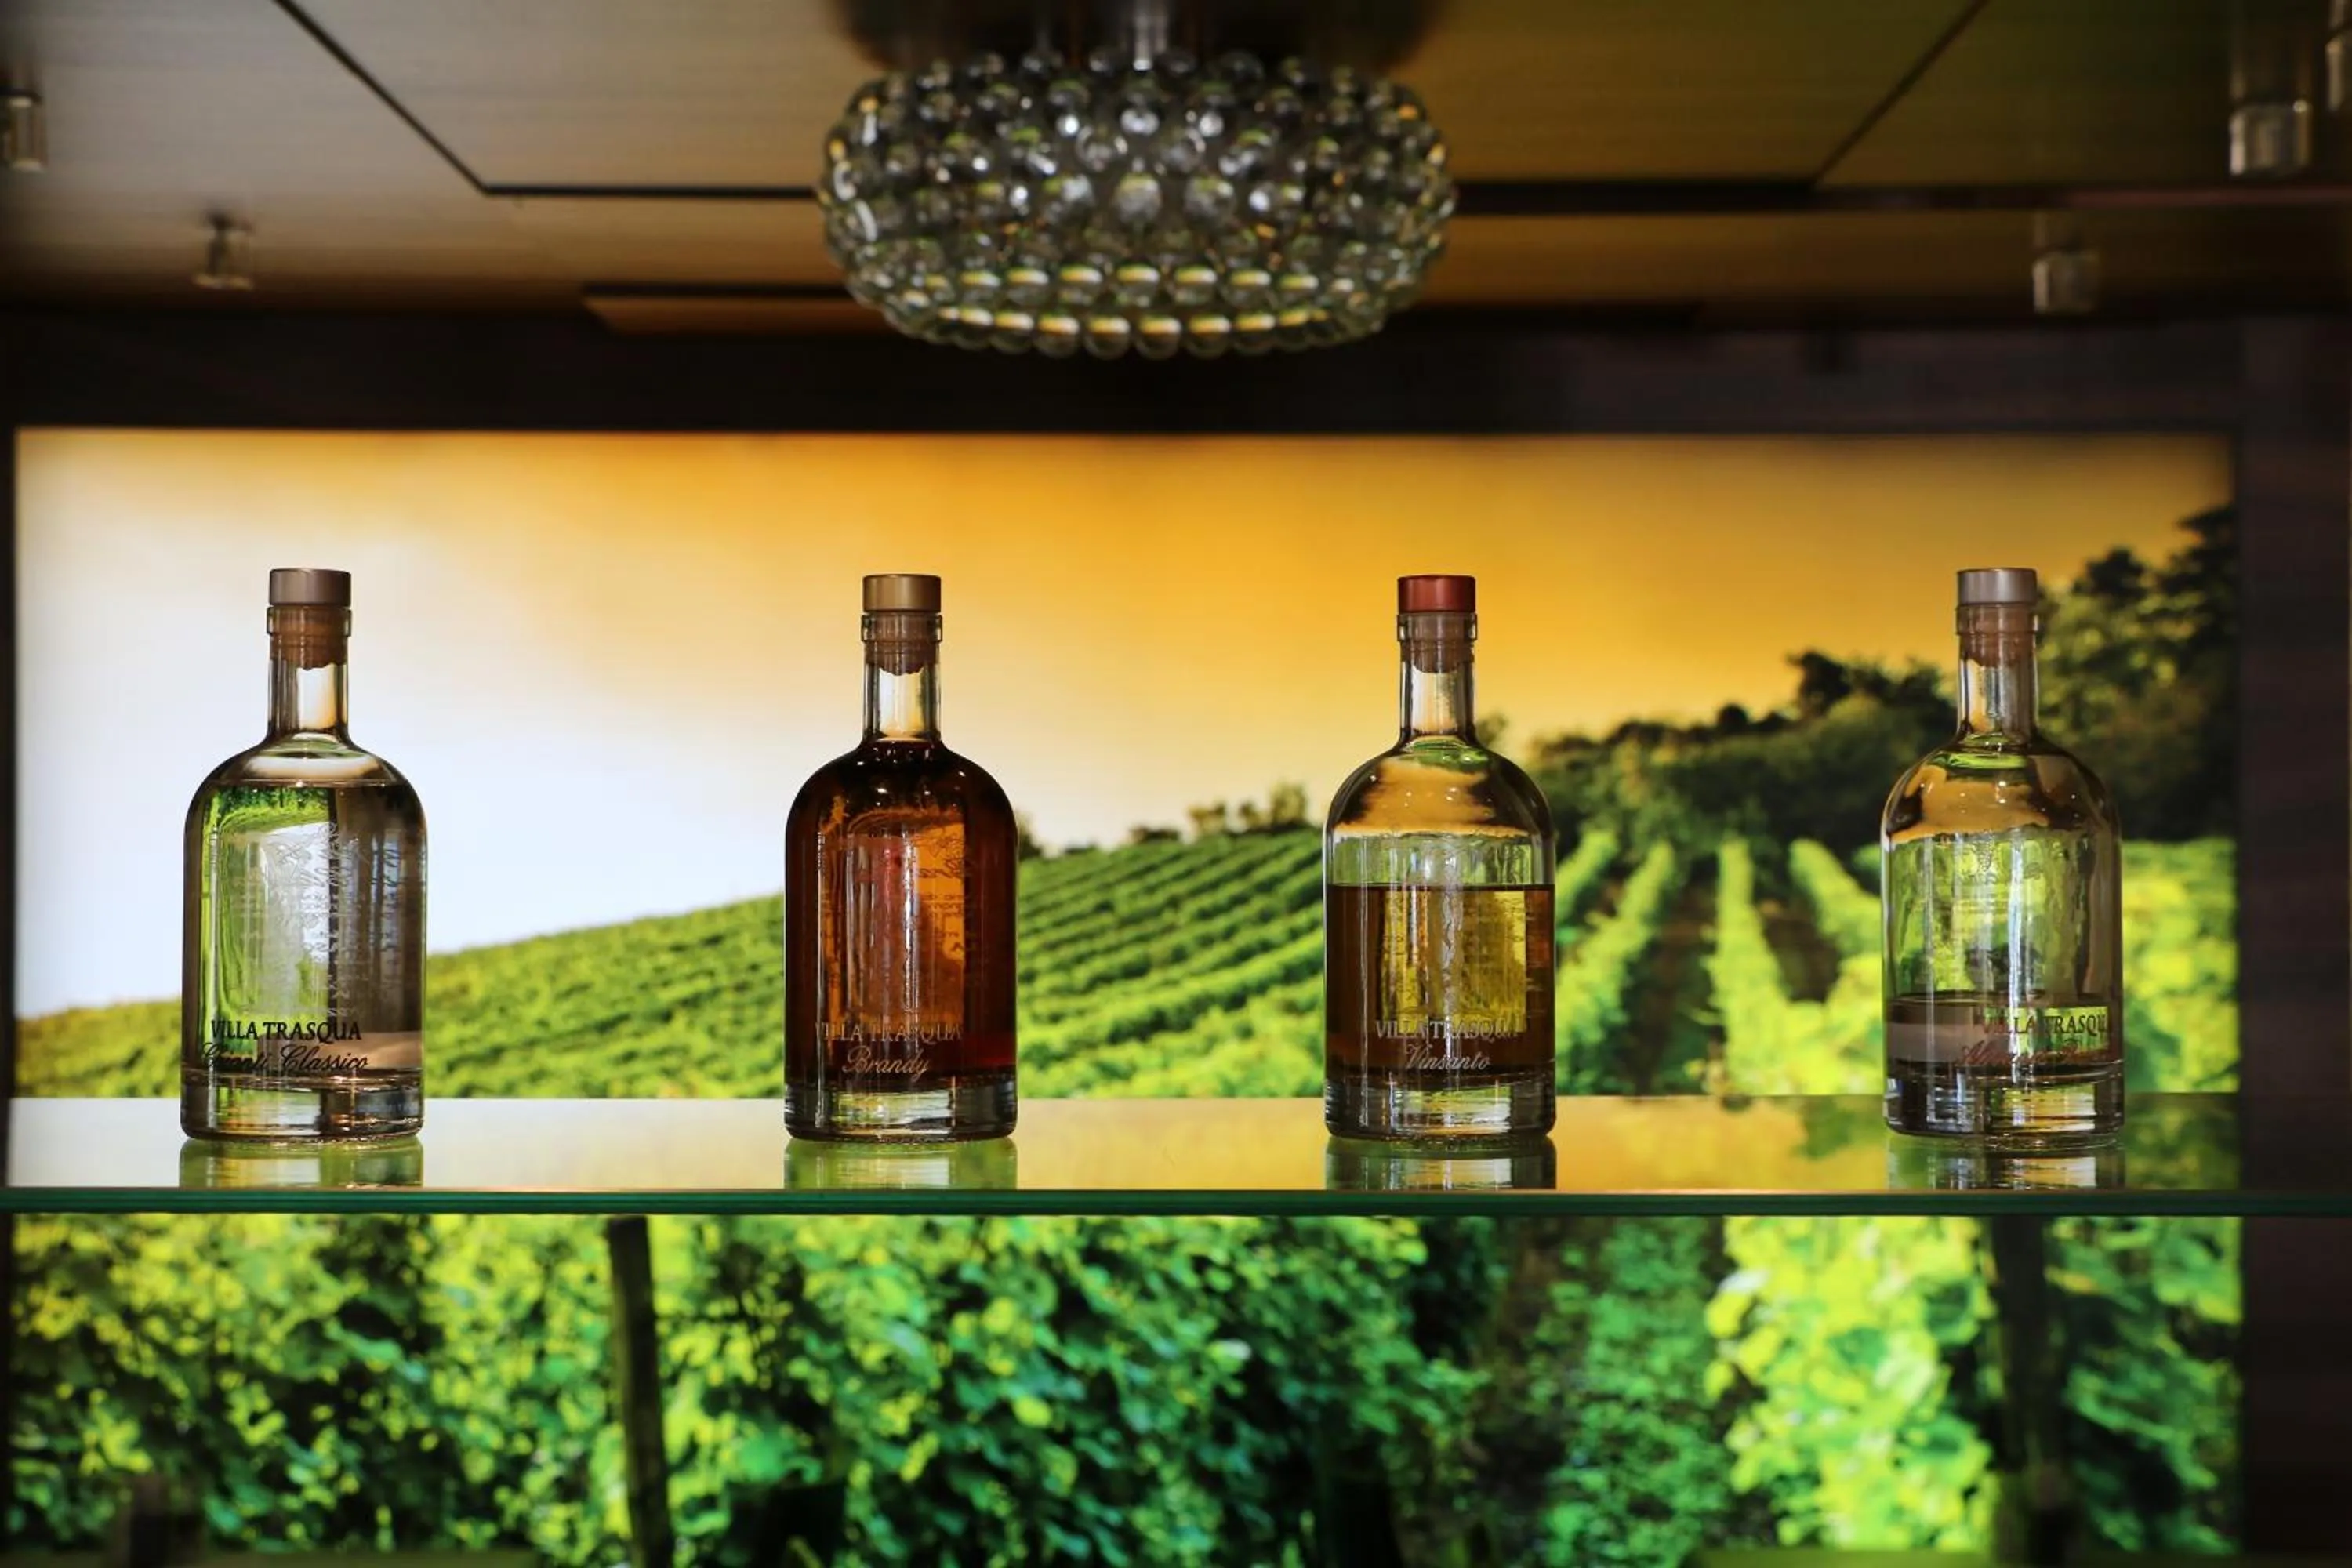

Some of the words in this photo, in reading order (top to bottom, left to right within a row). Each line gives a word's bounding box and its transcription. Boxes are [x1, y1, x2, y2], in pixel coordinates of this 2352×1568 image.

[211, 1021, 258, 1040] VILLA
[263, 1022, 362, 1044] TRASQUA
[2043, 1016, 2111, 1036] TRASQU
[280, 1044, 368, 1072] Classico
[841, 1044, 930, 1083] Brandy
